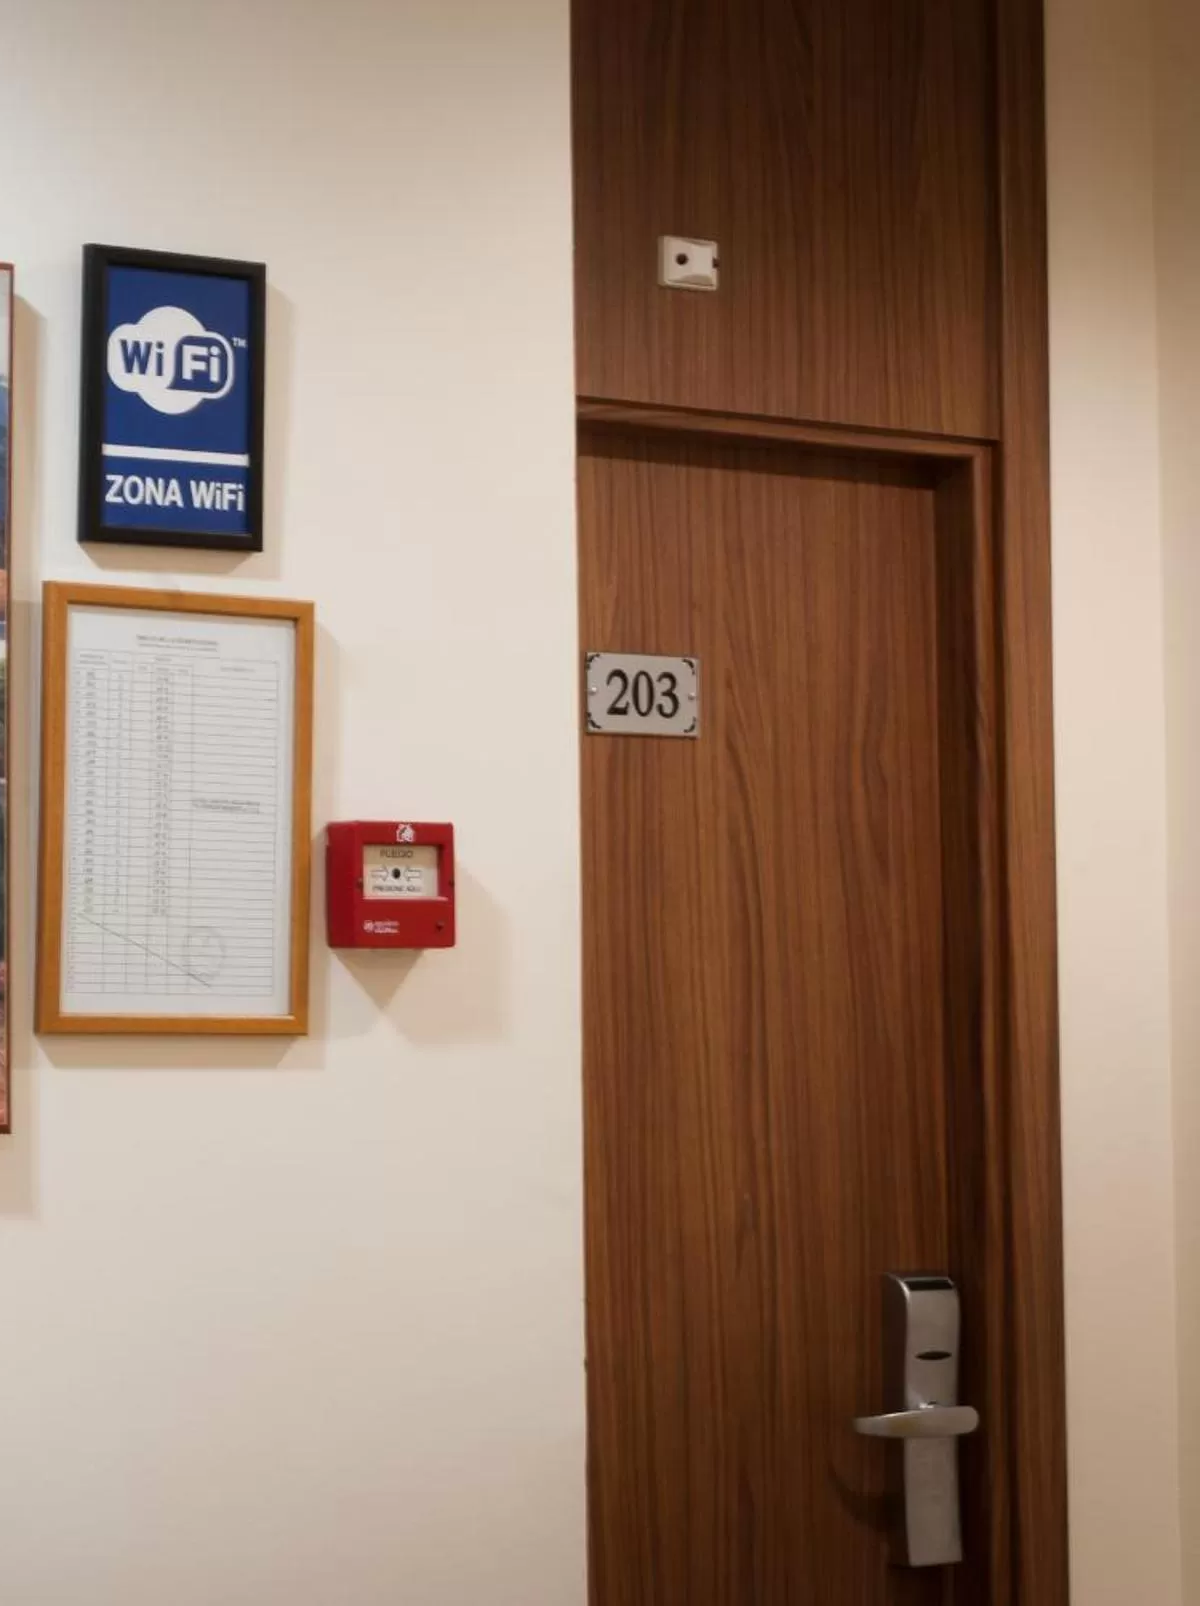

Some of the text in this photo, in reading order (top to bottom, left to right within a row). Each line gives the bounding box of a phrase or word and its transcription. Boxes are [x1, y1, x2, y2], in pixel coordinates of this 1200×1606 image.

[104, 474, 245, 512] ZONA WiFi
[606, 668, 680, 719] 203
